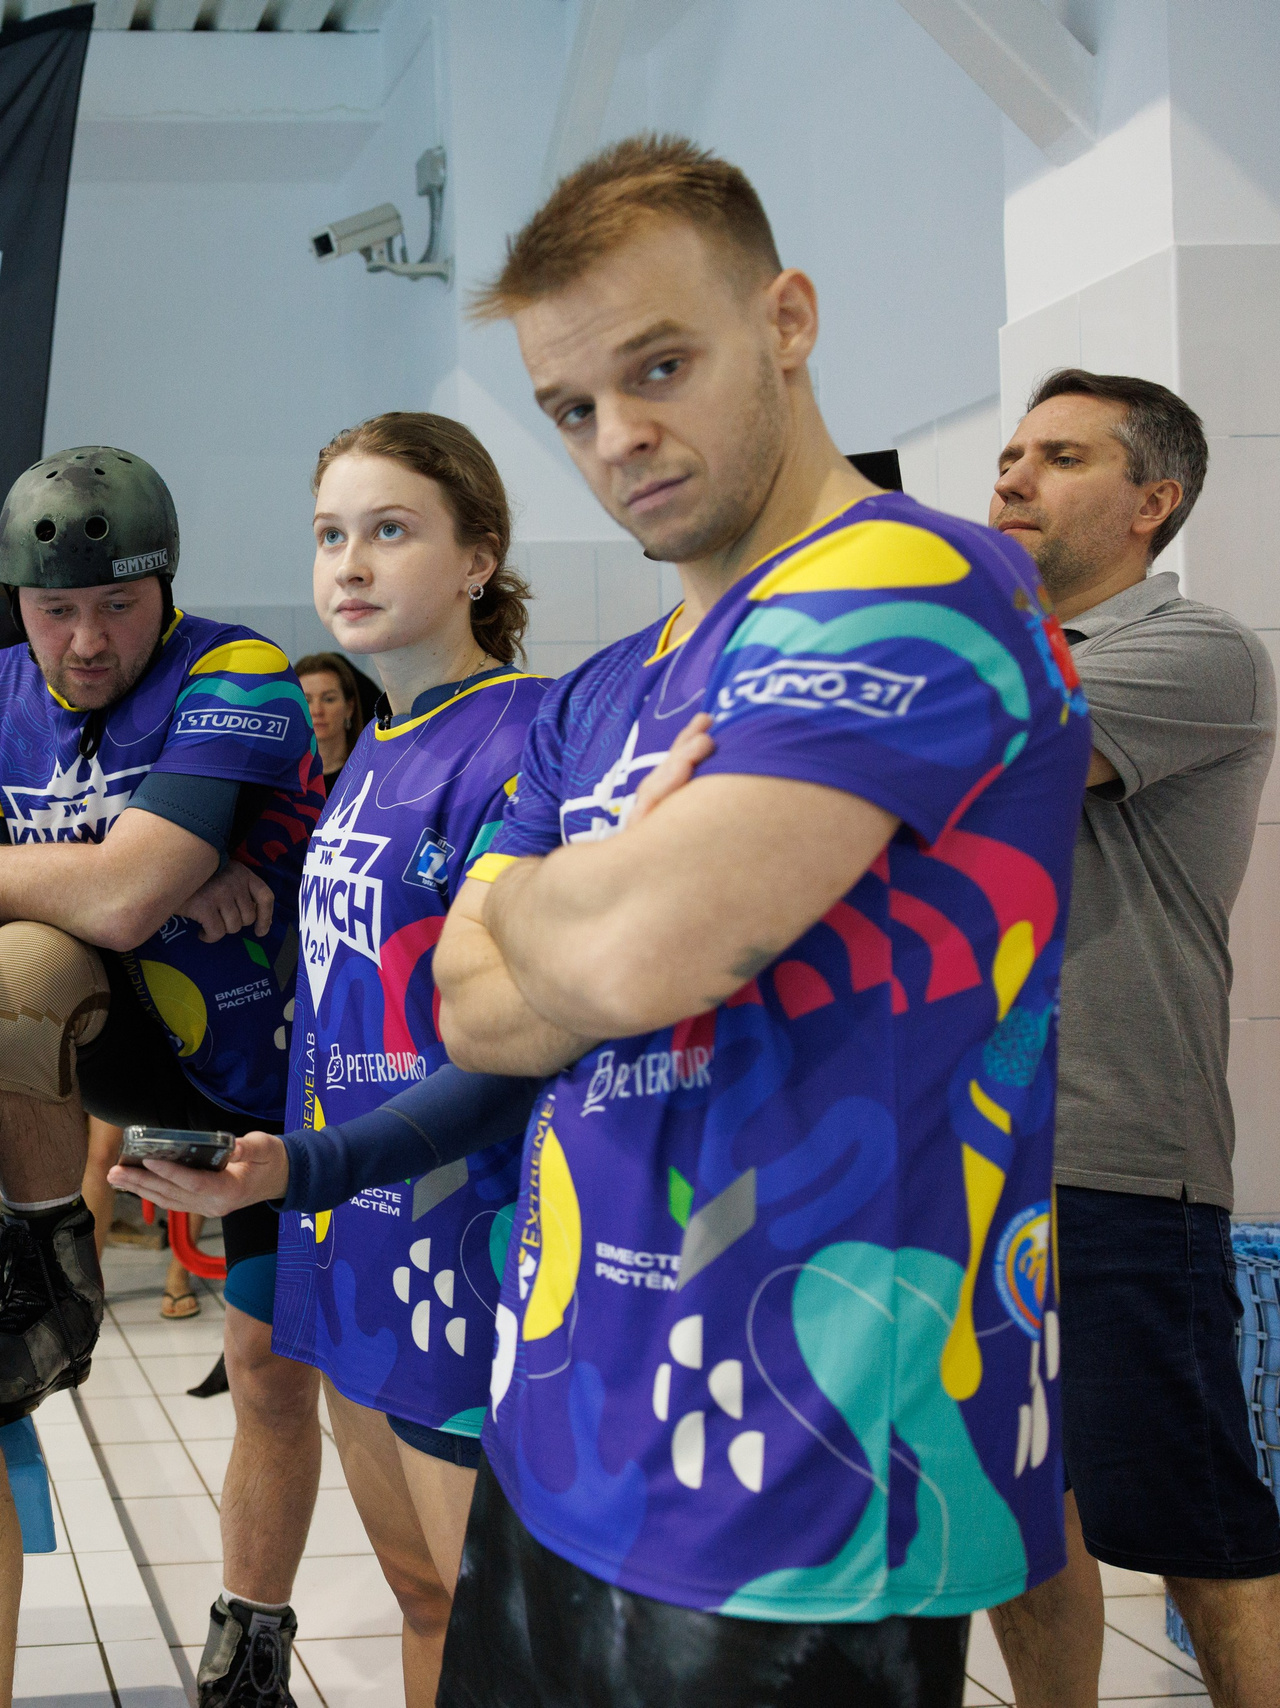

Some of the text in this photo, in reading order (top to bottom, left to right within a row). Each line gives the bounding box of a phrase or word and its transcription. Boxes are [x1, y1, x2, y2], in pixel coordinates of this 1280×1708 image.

[126, 548, 169, 573] MYSTIC
[187, 714, 283, 734] STUDIO 21
[301, 873, 376, 955] WWCH
[215, 978, 270, 1002] ВМЕСТЕ
[217, 988, 272, 1011] РАСТЁМ
[349, 1196, 401, 1217] АСТЁМ
[361, 1187, 402, 1204] ЕСТЕ
